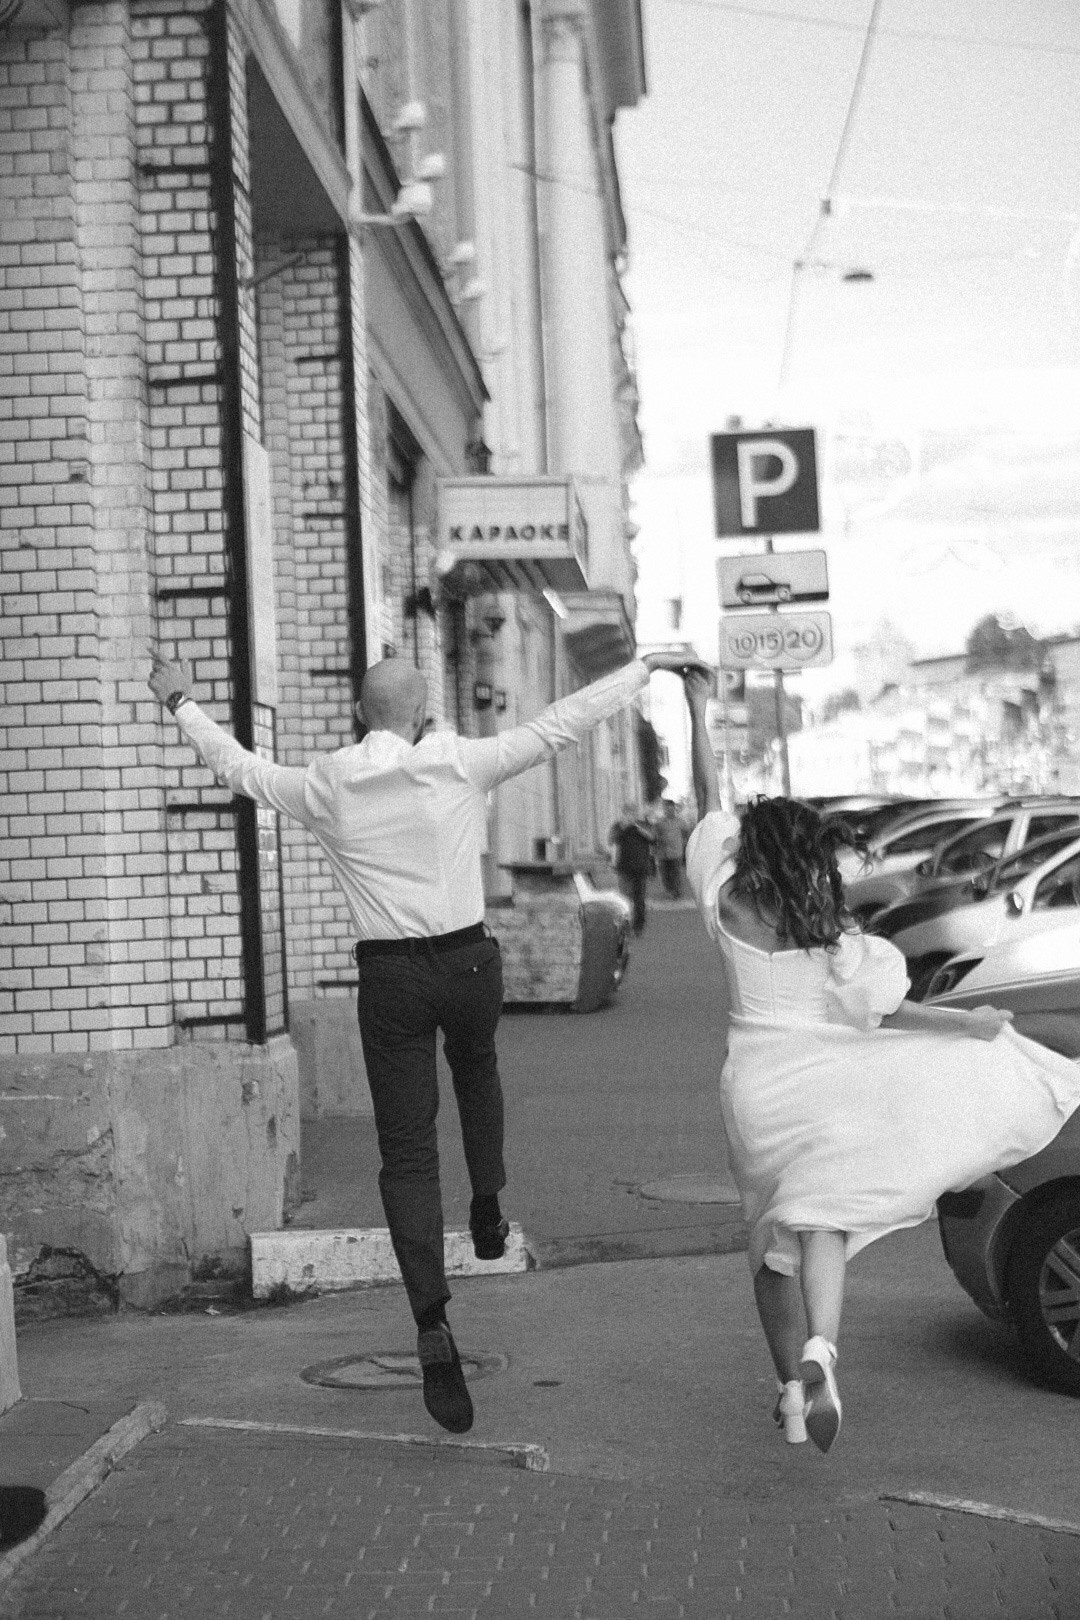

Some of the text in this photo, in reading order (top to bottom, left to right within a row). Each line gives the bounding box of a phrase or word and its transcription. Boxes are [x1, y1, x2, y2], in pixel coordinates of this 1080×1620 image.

[736, 439, 798, 528] P
[449, 523, 569, 541] КАРАОКЕ
[734, 629, 817, 651] 10 15 20
